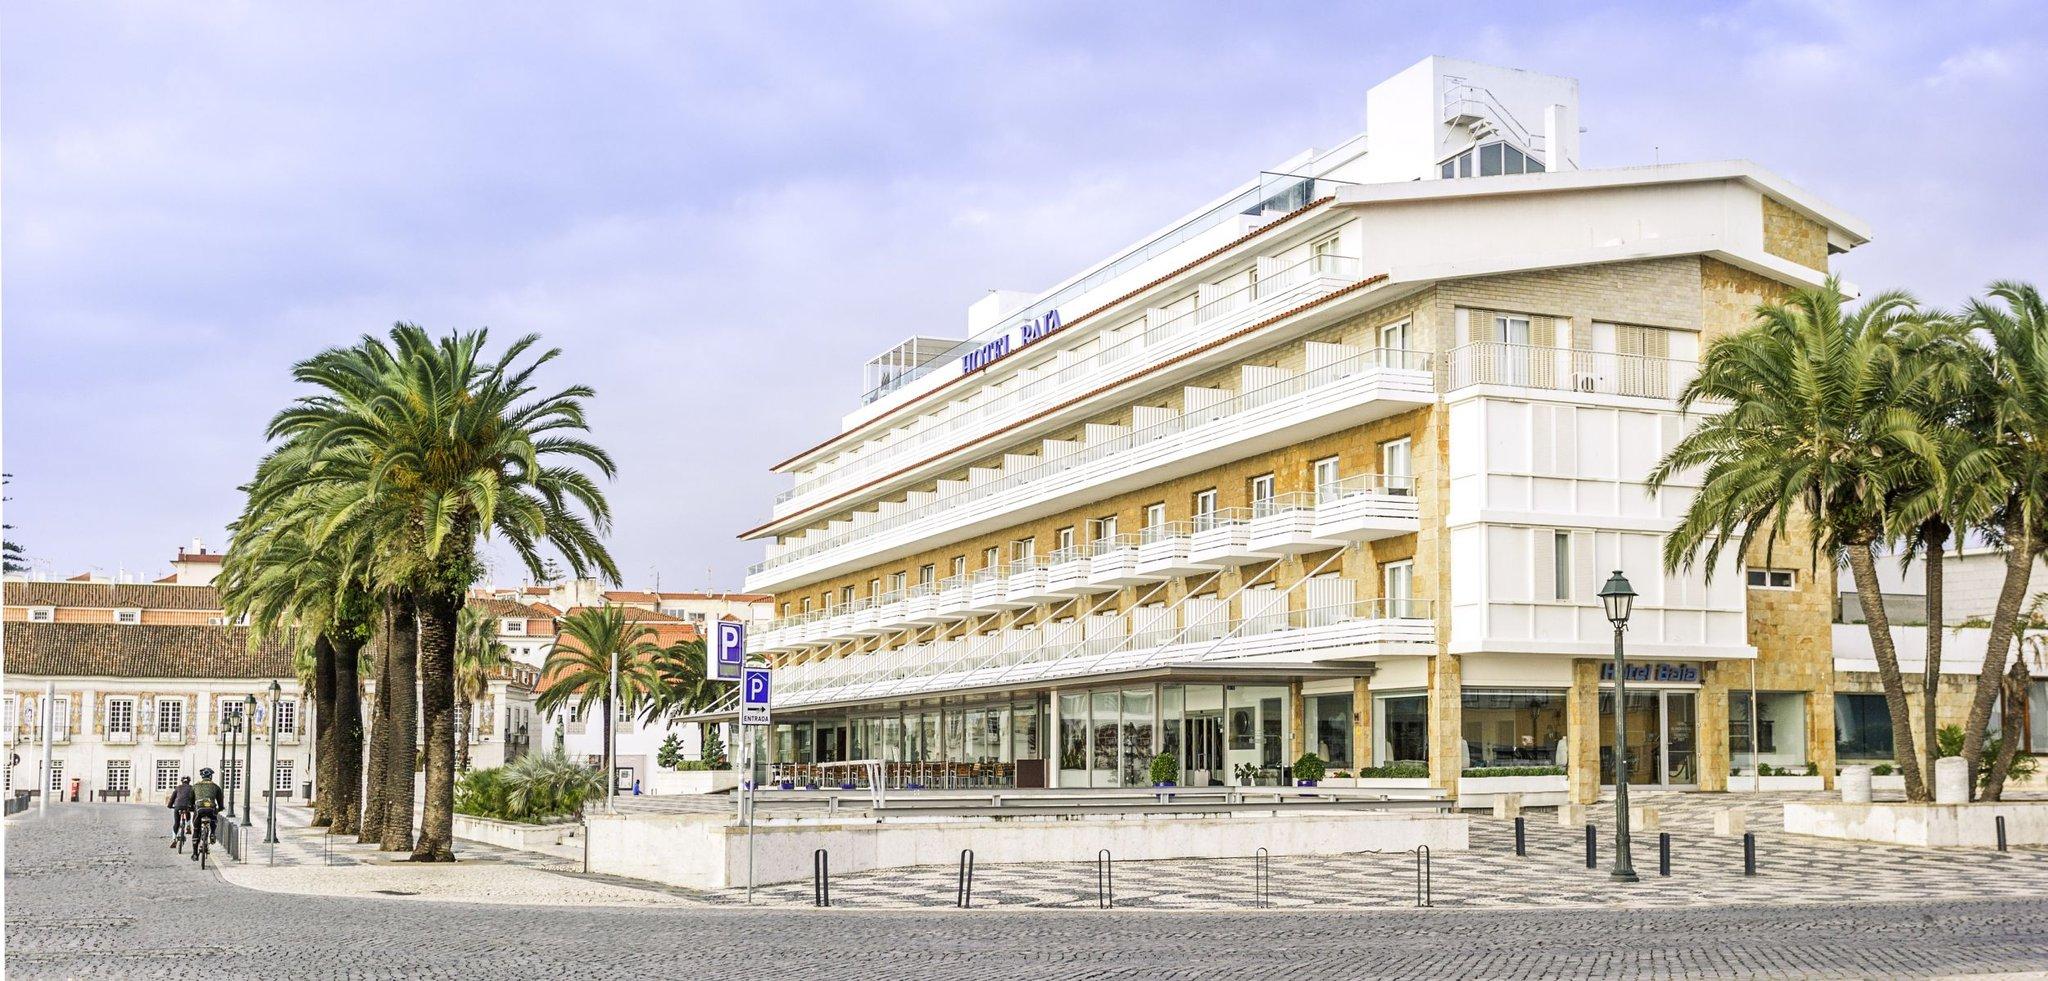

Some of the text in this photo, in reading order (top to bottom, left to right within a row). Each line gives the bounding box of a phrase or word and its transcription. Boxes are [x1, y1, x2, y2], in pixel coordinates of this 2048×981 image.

[962, 334, 1010, 374] HOTEL
[721, 626, 738, 660] P
[1602, 663, 1651, 681] Htel
[751, 678, 763, 701] P
